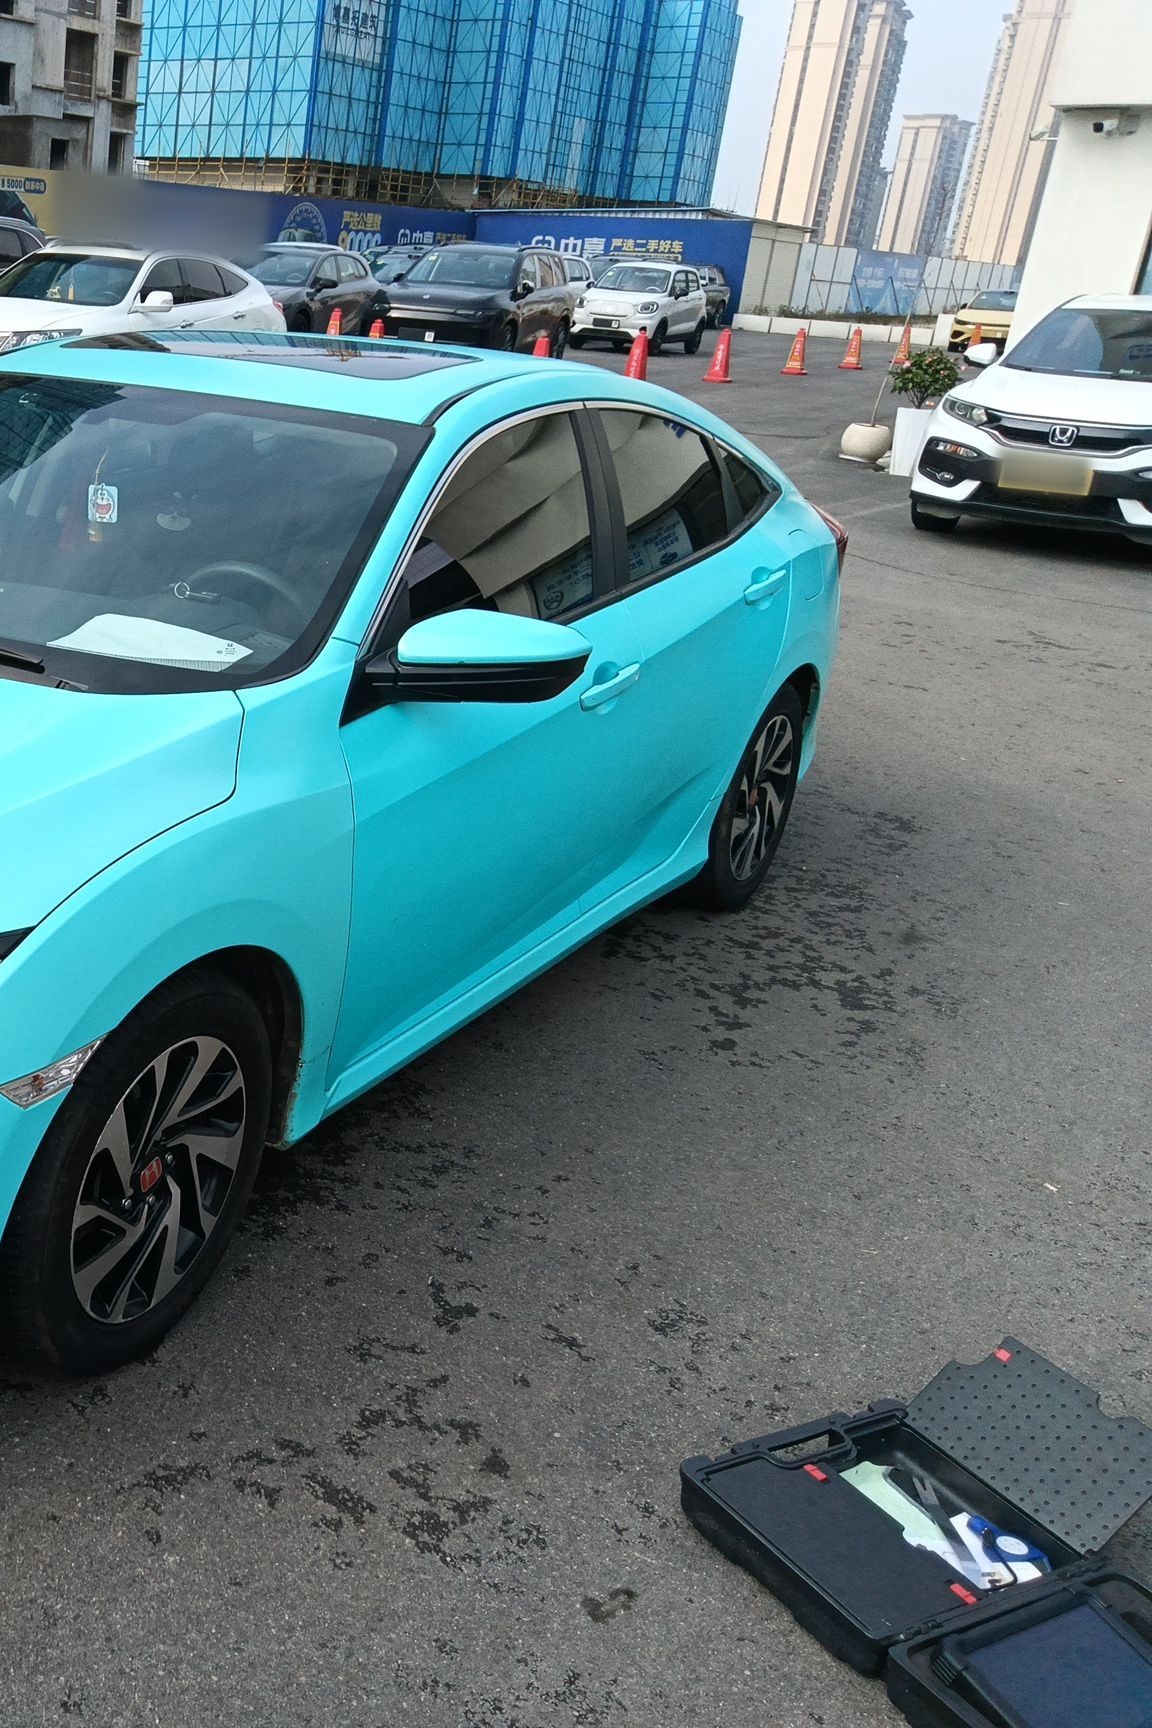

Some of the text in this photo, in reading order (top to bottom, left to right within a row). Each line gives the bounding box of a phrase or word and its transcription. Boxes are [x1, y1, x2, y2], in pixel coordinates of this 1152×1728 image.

[7, 178, 23, 189] 5000
[609, 238, 684, 254] 严选二手好车
